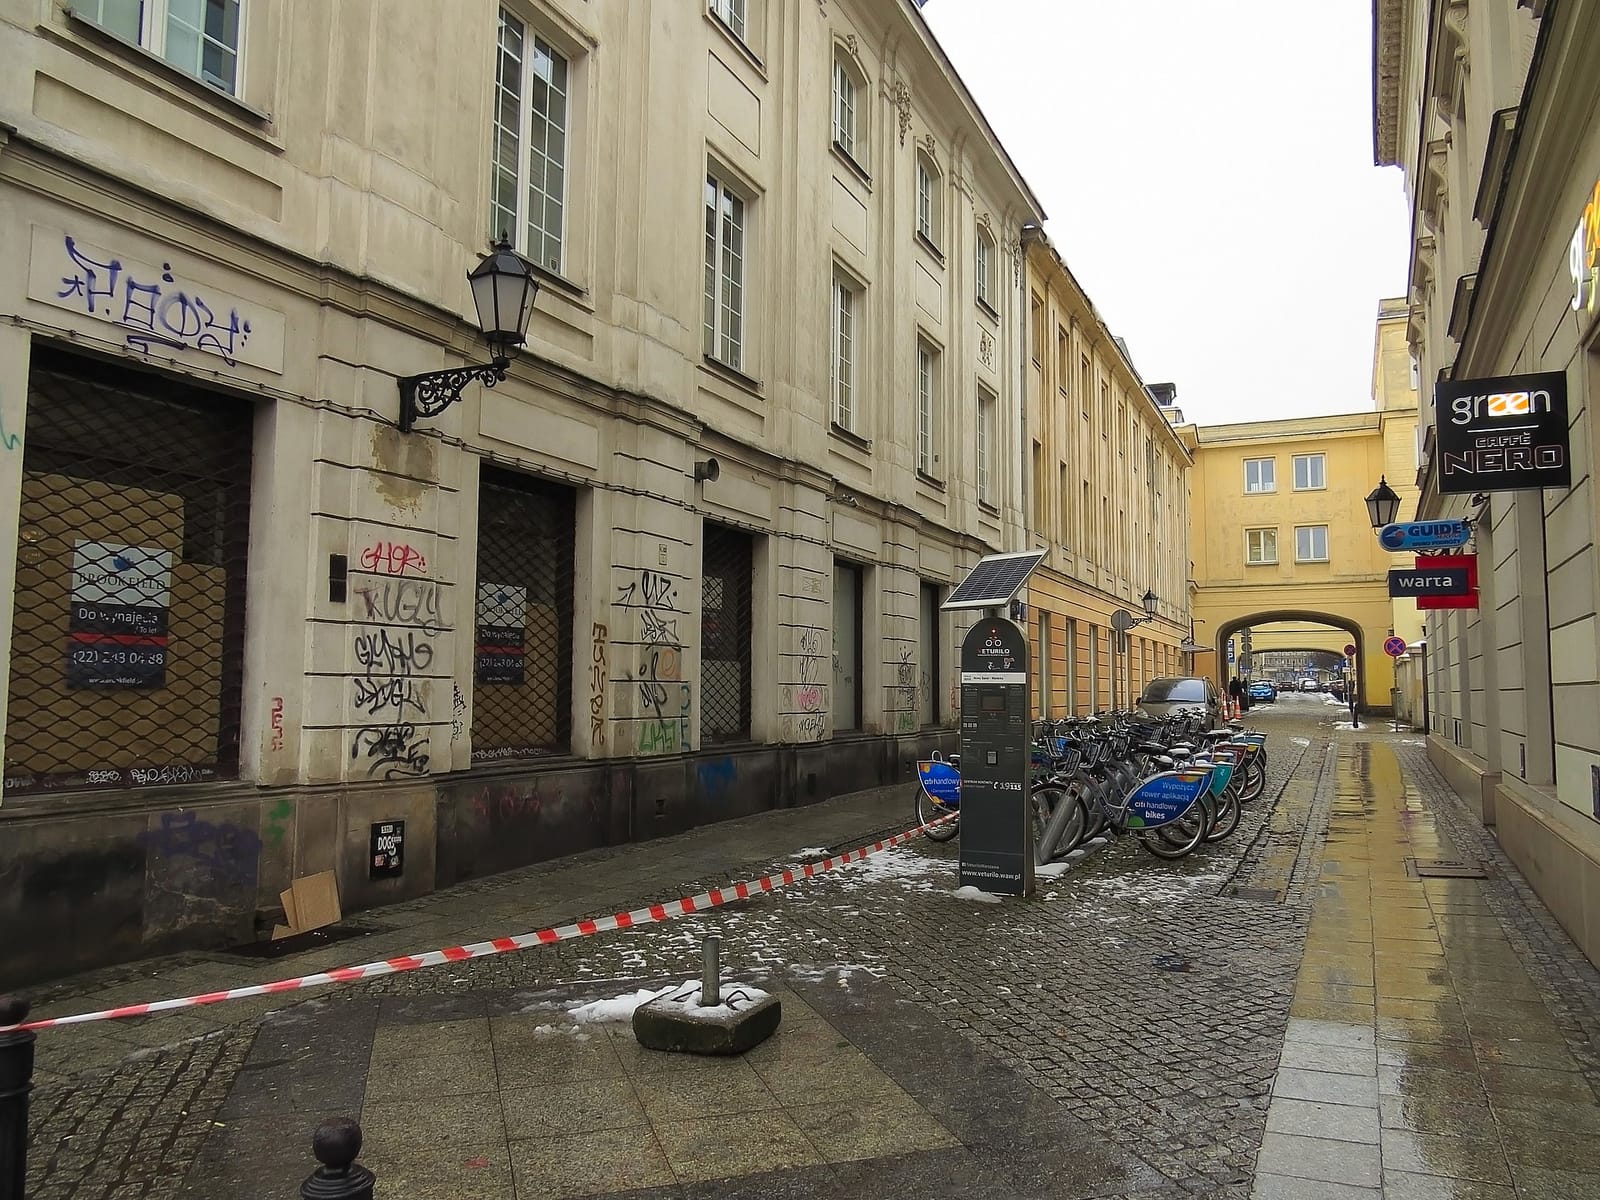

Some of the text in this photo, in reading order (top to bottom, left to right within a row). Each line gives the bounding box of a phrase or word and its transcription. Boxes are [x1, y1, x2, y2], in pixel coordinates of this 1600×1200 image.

[1443, 445, 1563, 475] NERO
[1408, 523, 1462, 538] GUIDE
[1398, 575, 1453, 588] warta
[79, 608, 96, 620] Do
[73, 650, 98, 665] (22)
[1162, 781, 1195, 792] Wypożycz
[1141, 791, 1190, 803] rower aplikacją
[1146, 801, 1178, 812] handlowy
[1145, 810, 1166, 820] bikes
